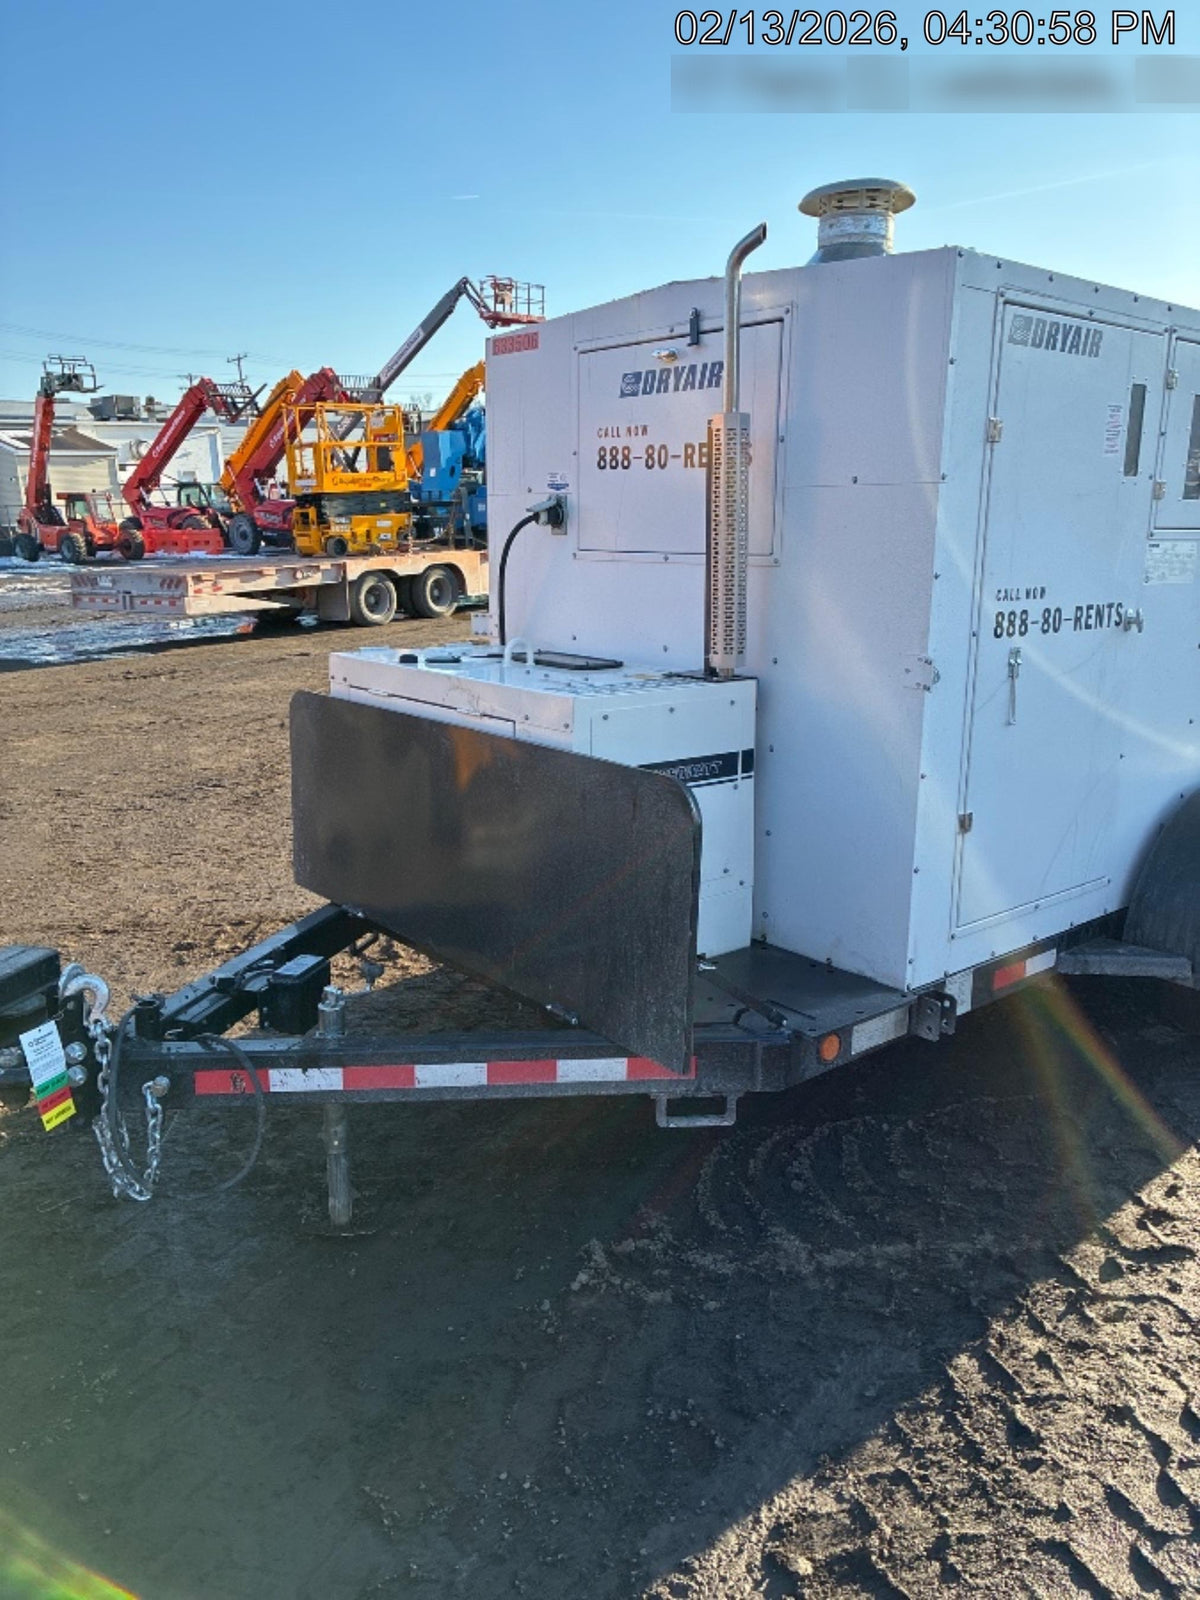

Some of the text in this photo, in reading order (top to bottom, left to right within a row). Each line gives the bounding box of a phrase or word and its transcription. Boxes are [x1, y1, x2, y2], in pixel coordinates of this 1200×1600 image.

[1031, 318, 1103, 358] DRYAIR
[642, 360, 724, 395] DRYAIR
[597, 424, 648, 439] CALL NOW
[597, 442, 753, 470] 888-80-RE
[995, 586, 1046, 602] CALL NOW
[993, 602, 1123, 639] 888-80-RENTS
